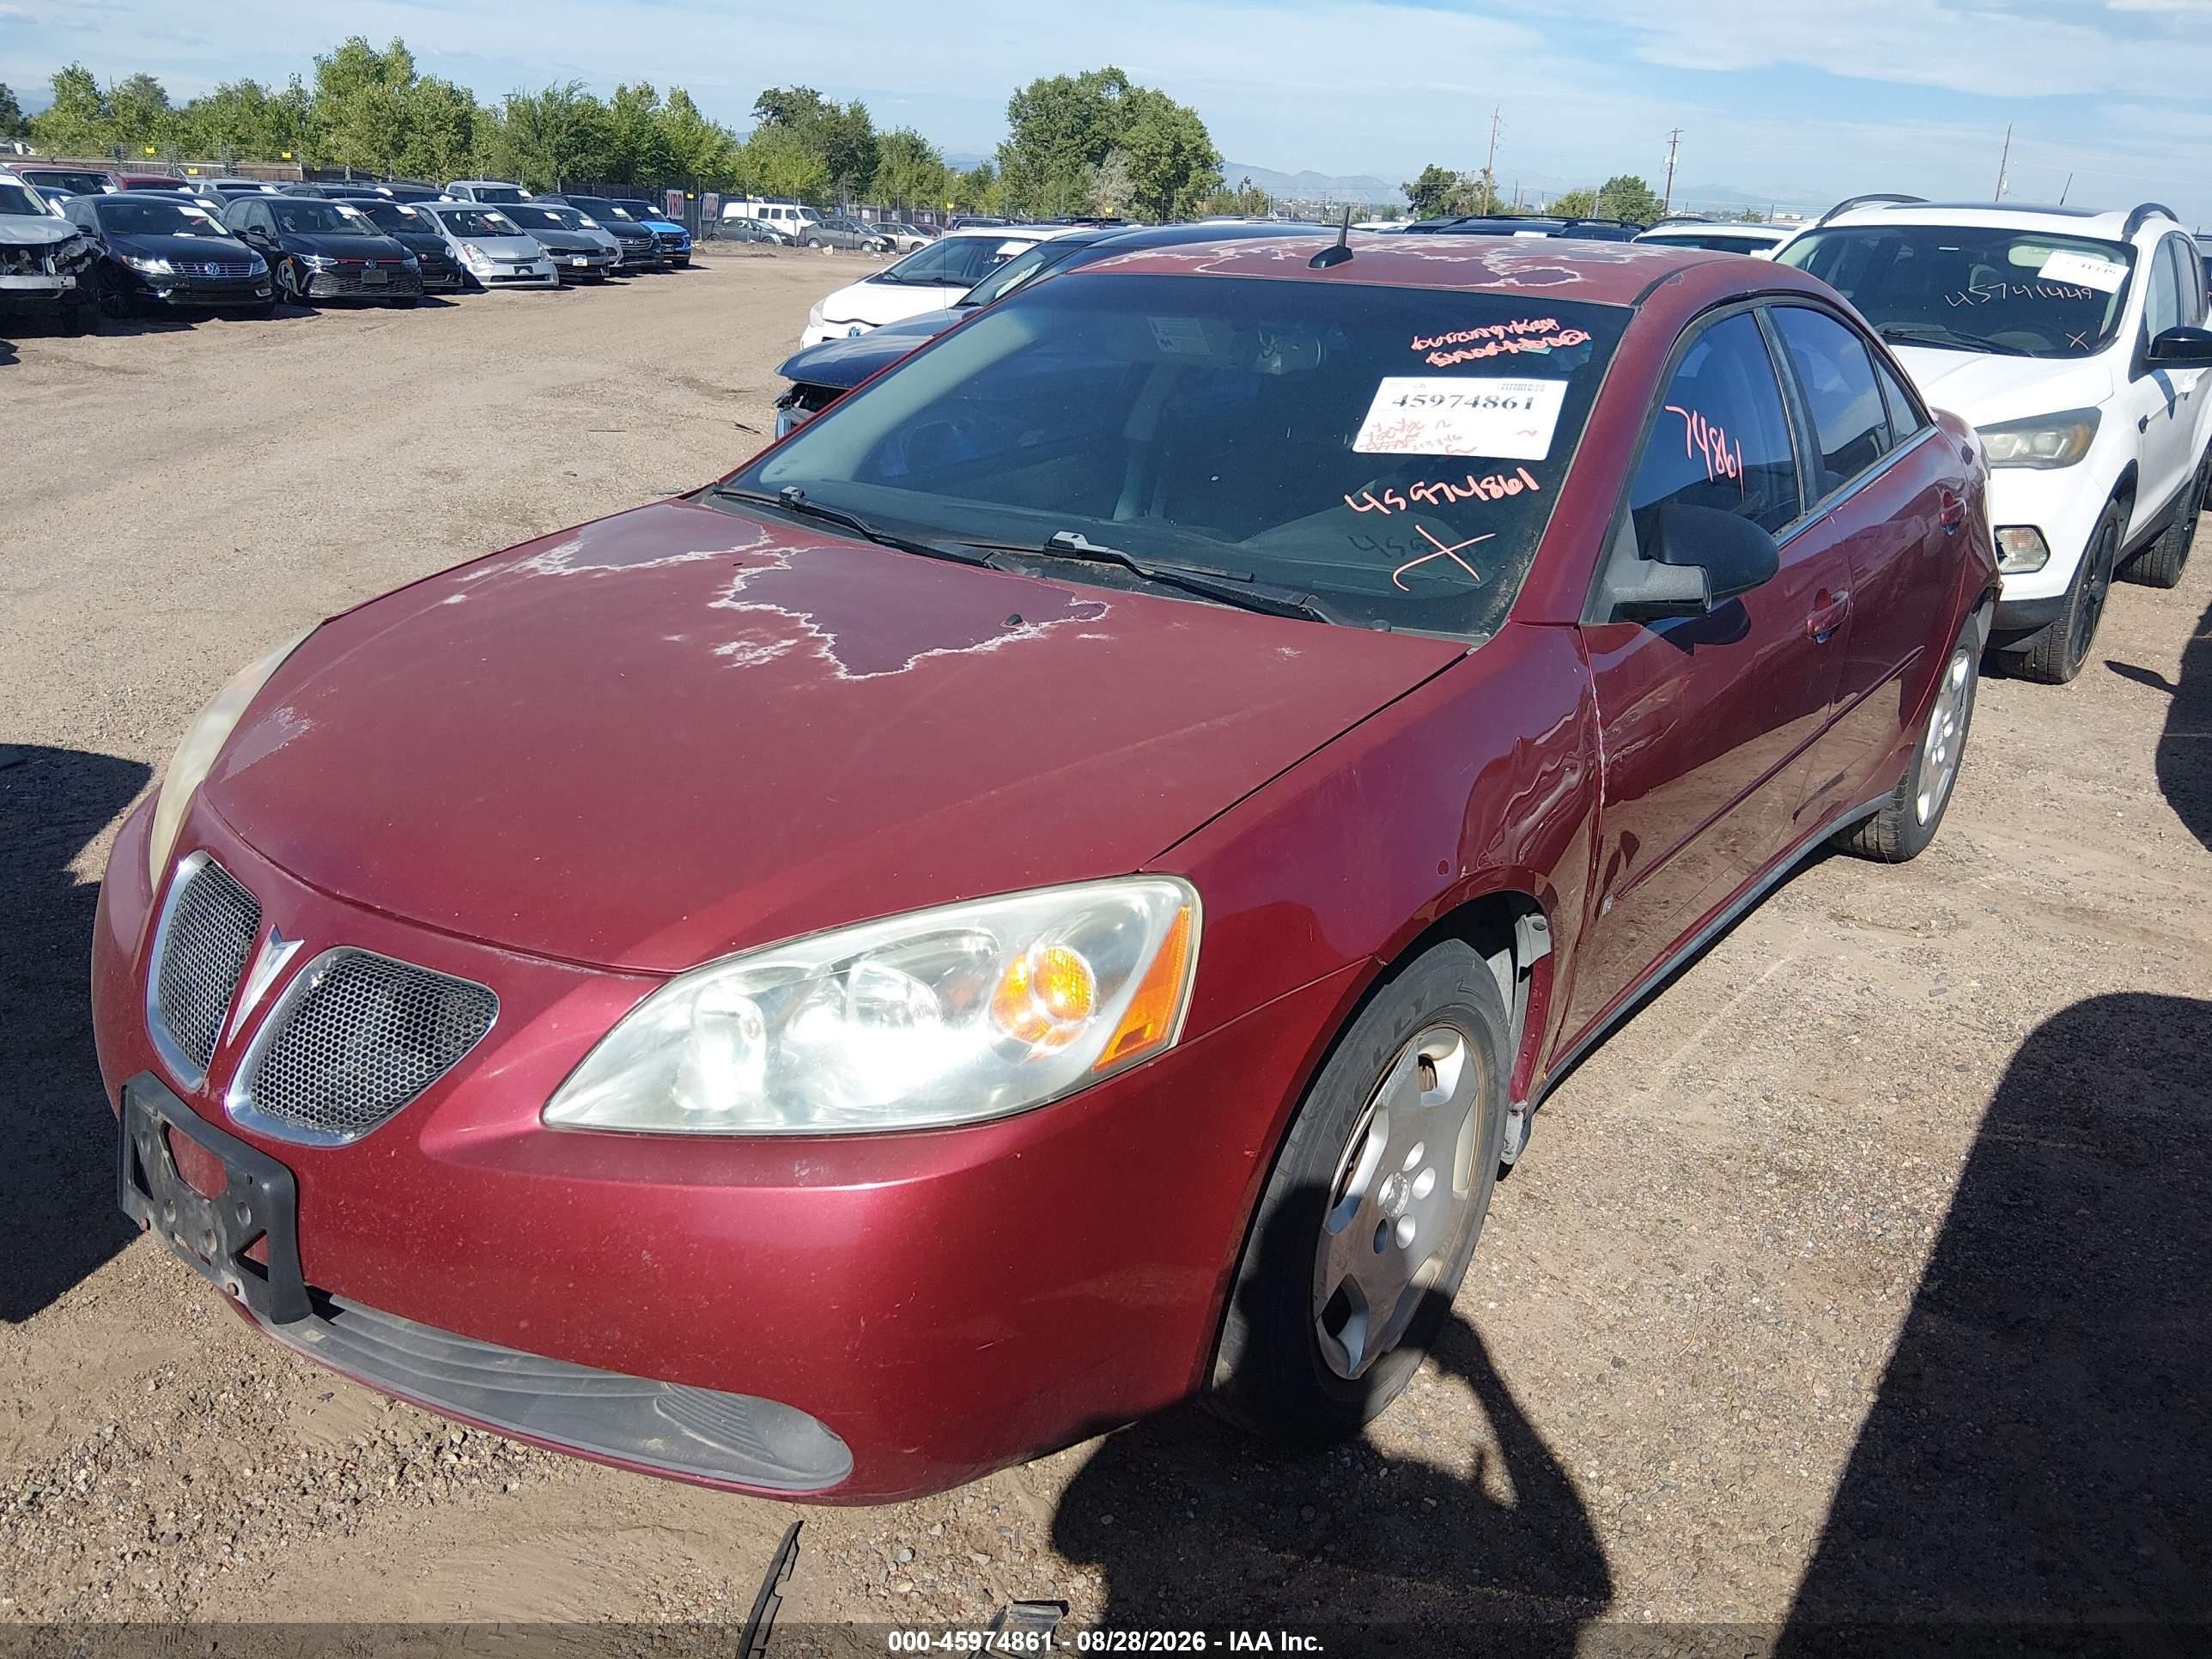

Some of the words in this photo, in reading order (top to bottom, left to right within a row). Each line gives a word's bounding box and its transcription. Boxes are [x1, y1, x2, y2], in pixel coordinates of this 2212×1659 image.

[1944, 283, 2093, 307] 45741449
[1391, 393, 1535, 411] 45974861
[1344, 467, 1540, 515] 45974861
